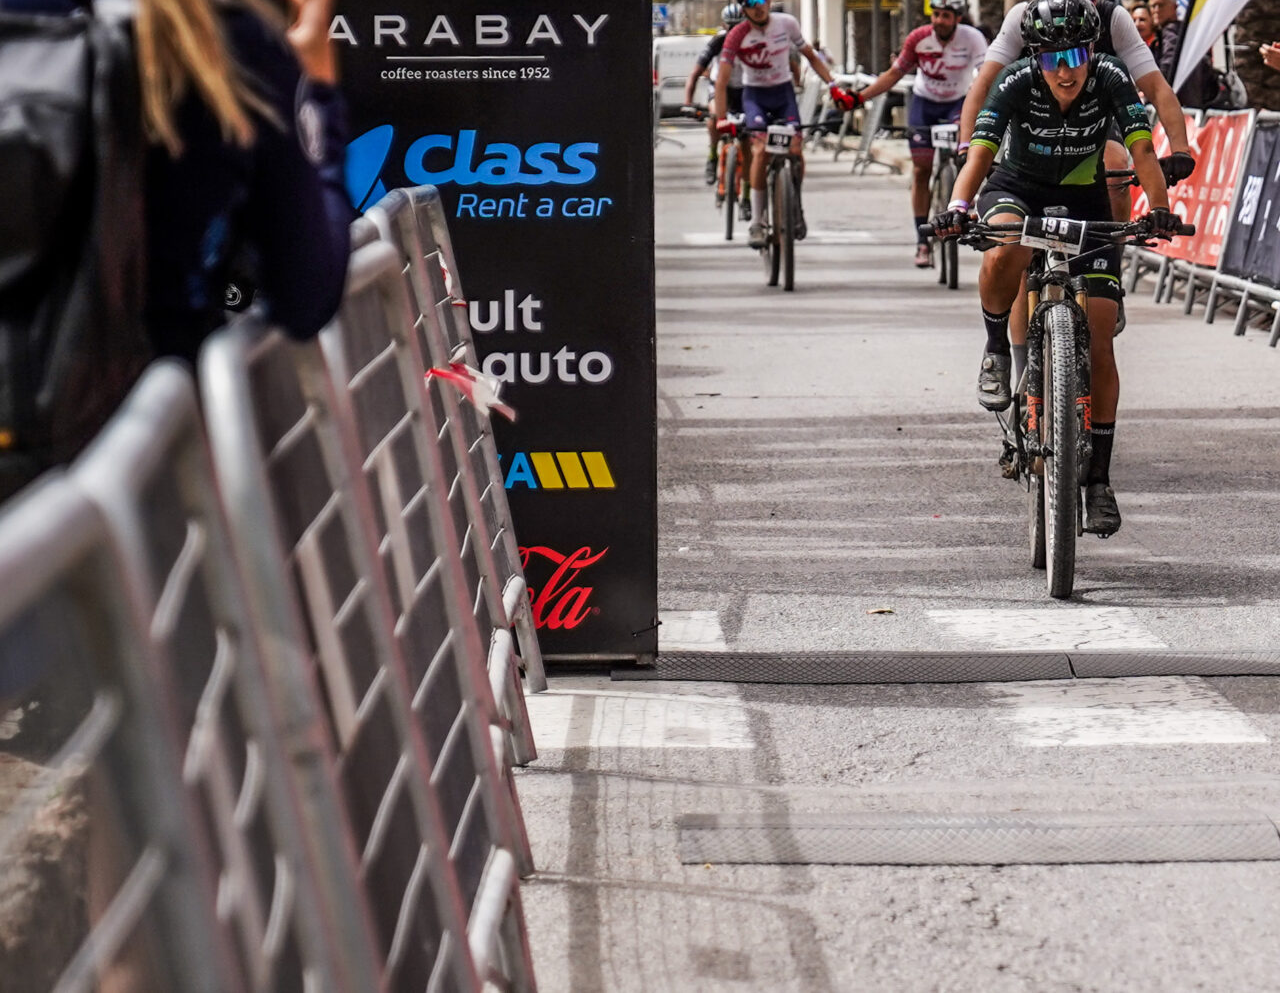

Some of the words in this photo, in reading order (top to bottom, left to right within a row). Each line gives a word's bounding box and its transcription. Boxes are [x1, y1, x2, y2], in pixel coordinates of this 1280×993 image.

[327, 13, 610, 47] ARABAY
[381, 66, 422, 80] coffee
[425, 68, 479, 80] roasters
[482, 66, 517, 80] since
[519, 66, 551, 80] 1952
[403, 129, 600, 187] Class
[456, 193, 527, 219] Rent
[535, 197, 553, 218] a
[561, 196, 613, 219] car
[1041, 218, 1057, 233] 19
